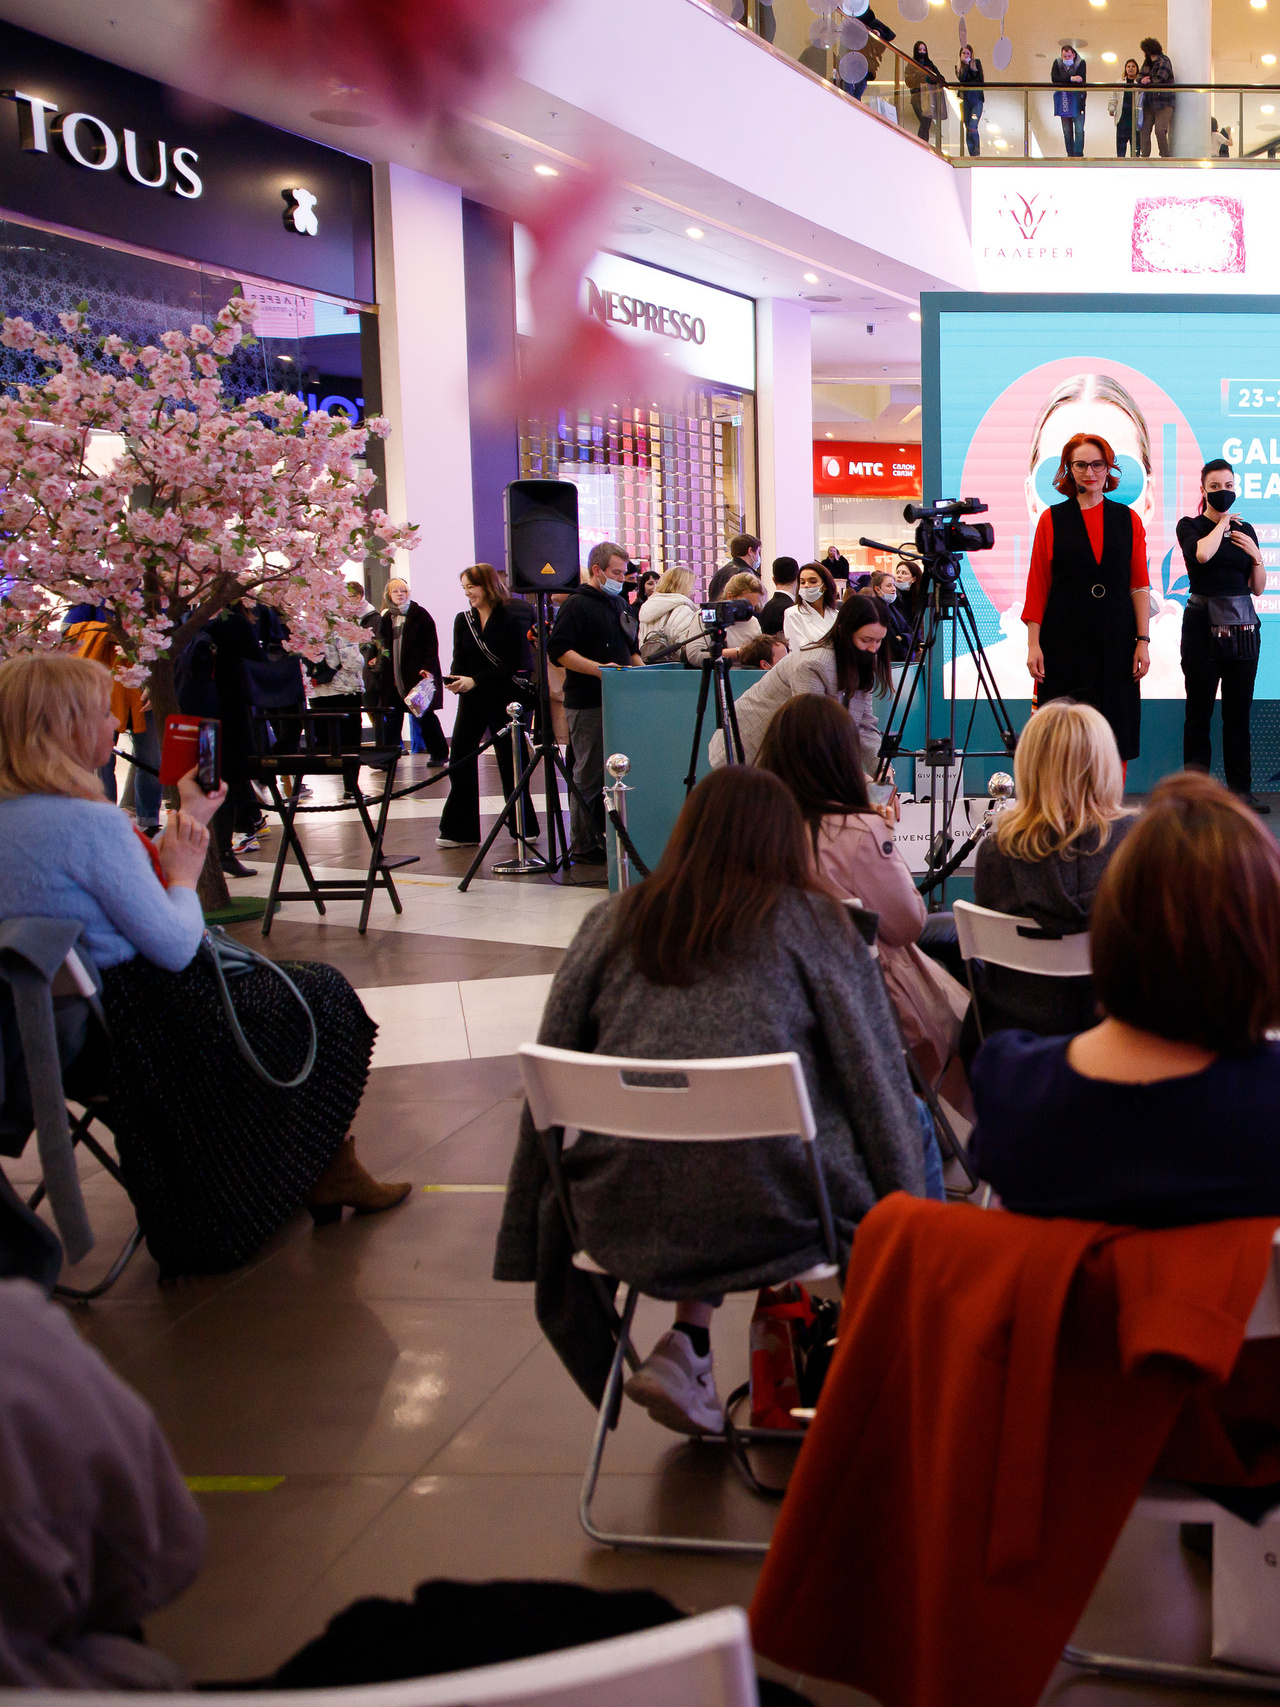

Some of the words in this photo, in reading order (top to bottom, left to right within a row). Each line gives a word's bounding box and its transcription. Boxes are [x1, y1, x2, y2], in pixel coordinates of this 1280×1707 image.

[14, 89, 204, 200] TOUS
[984, 247, 1073, 259] ГАЛЕРЕЯ
[583, 276, 706, 345] NESPRESSO
[848, 461, 884, 476] МТС
[892, 834, 931, 842] GIVENC
